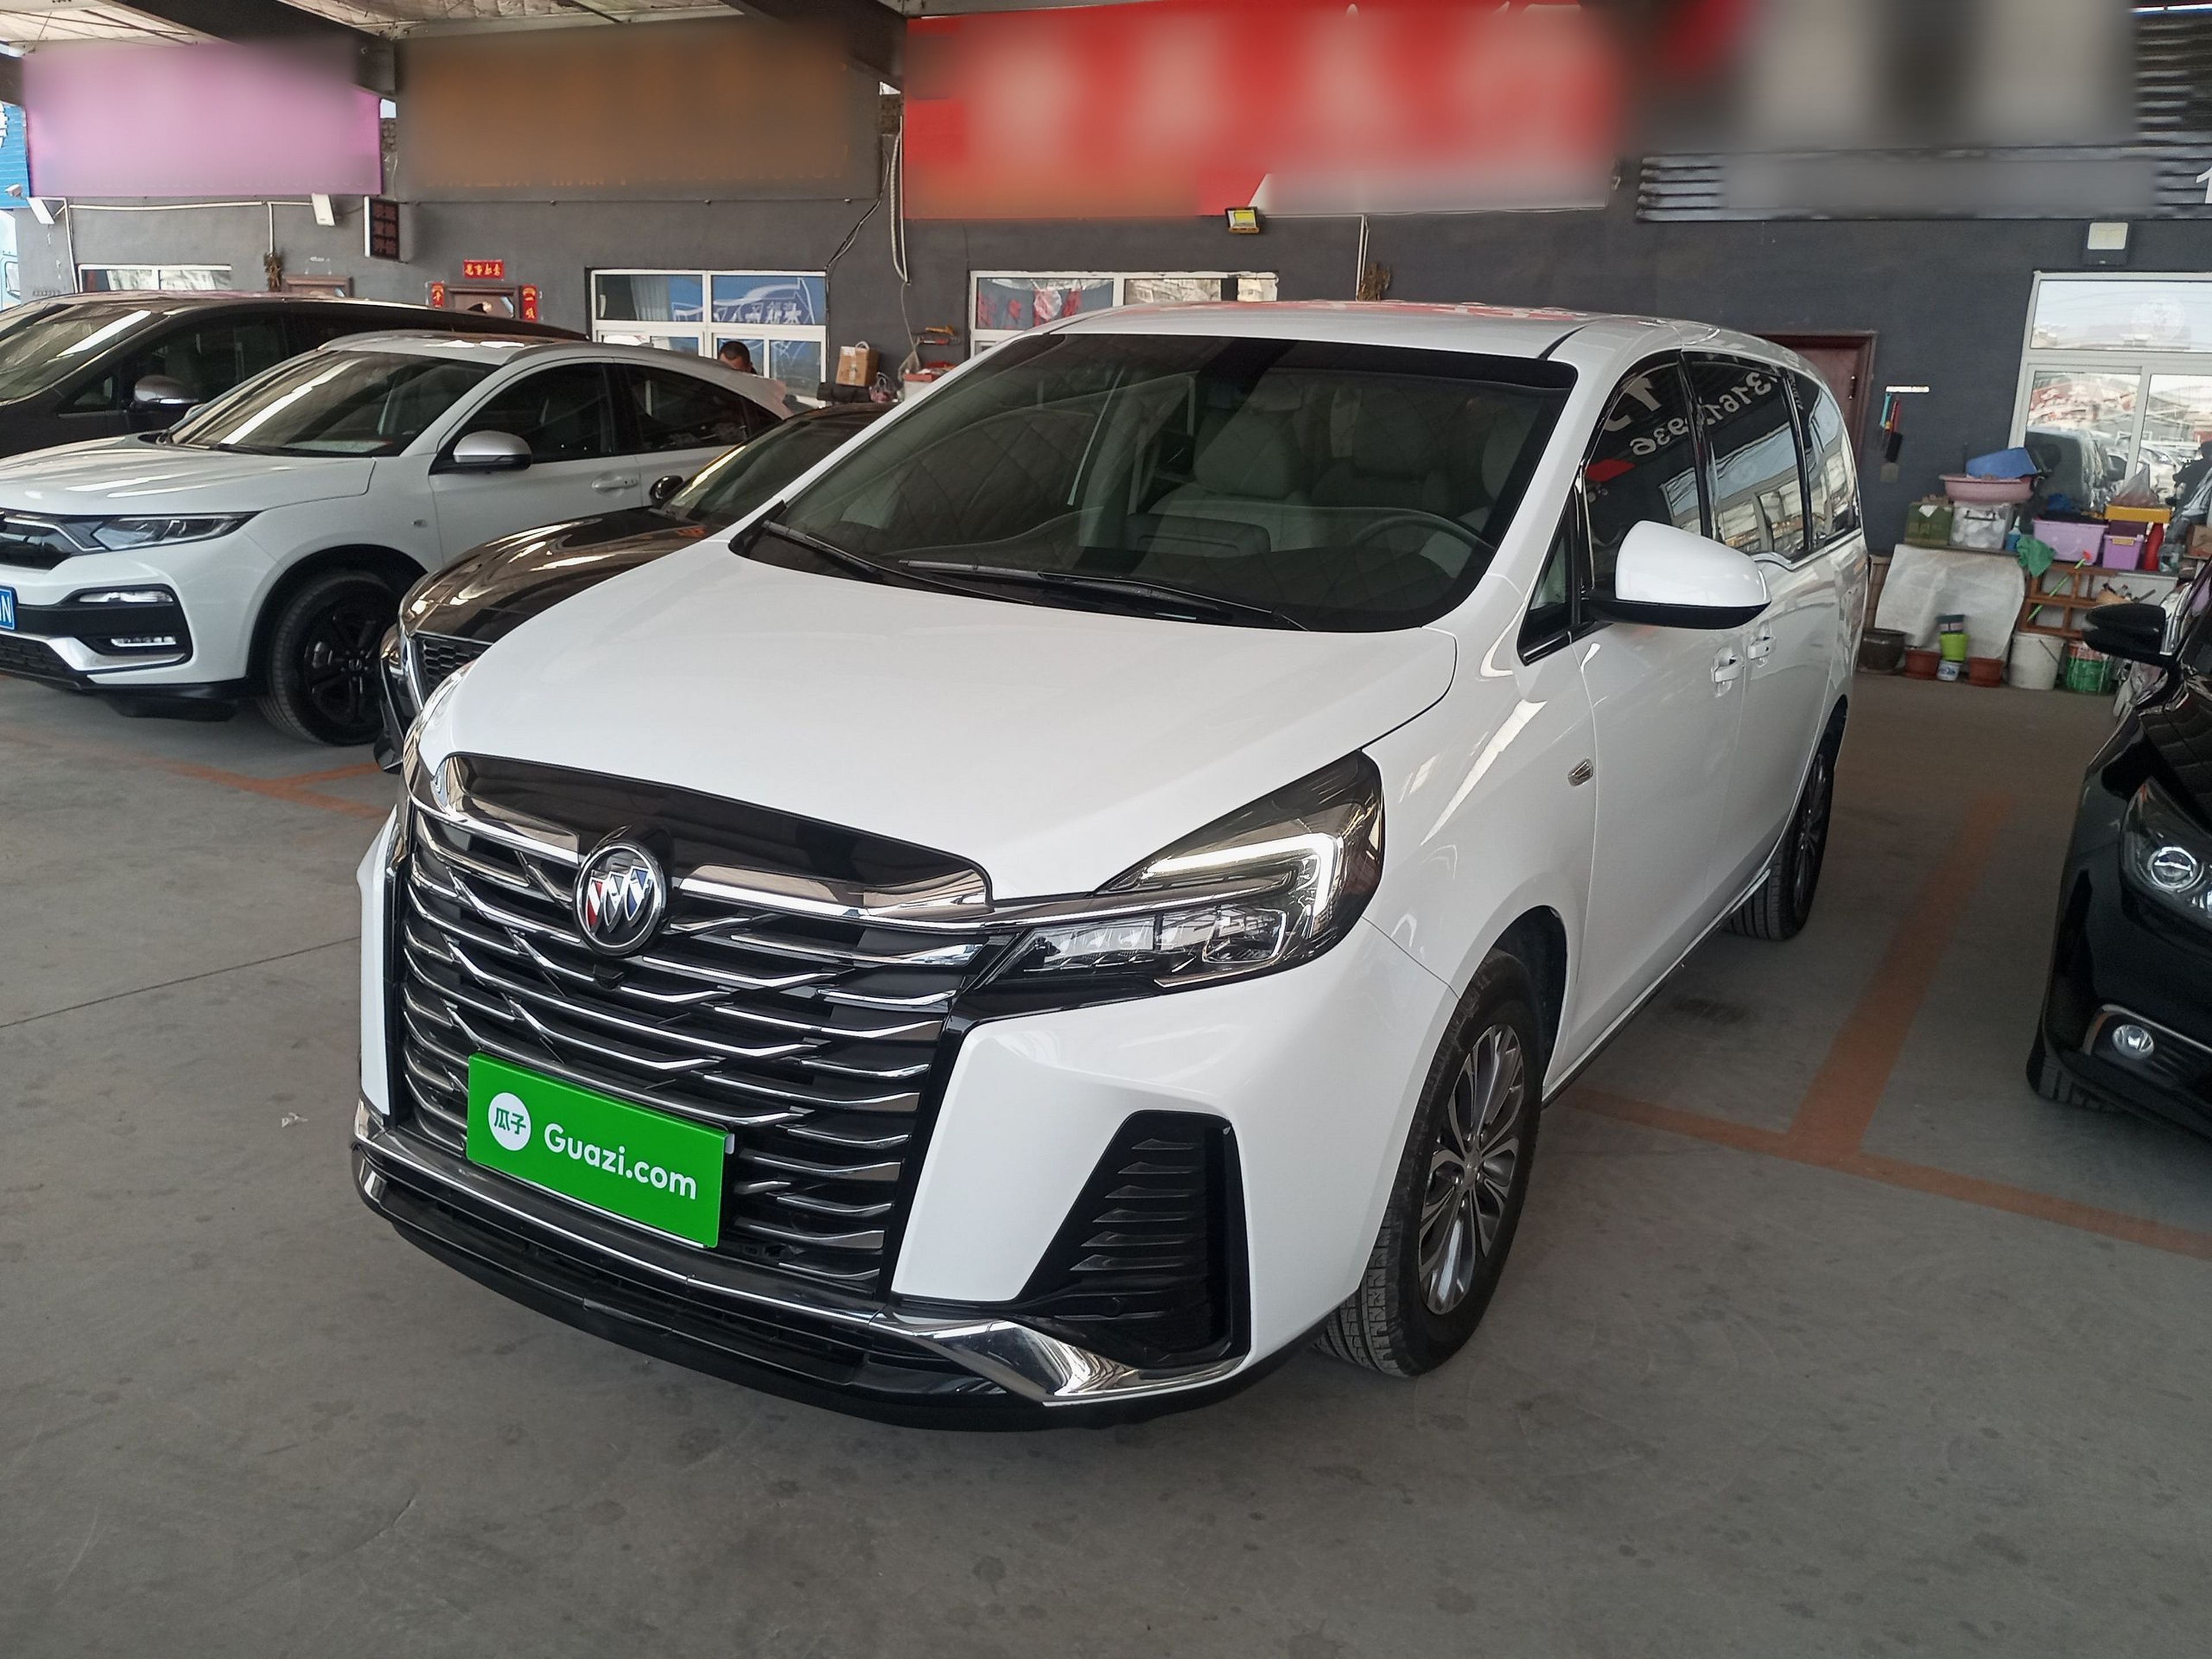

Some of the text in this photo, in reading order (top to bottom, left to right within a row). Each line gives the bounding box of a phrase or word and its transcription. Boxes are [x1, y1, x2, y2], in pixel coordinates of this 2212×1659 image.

[0, 594, 12, 623] N
[494, 1107, 527, 1135] 瓜子
[544, 1123, 697, 1200] Guazi.com
